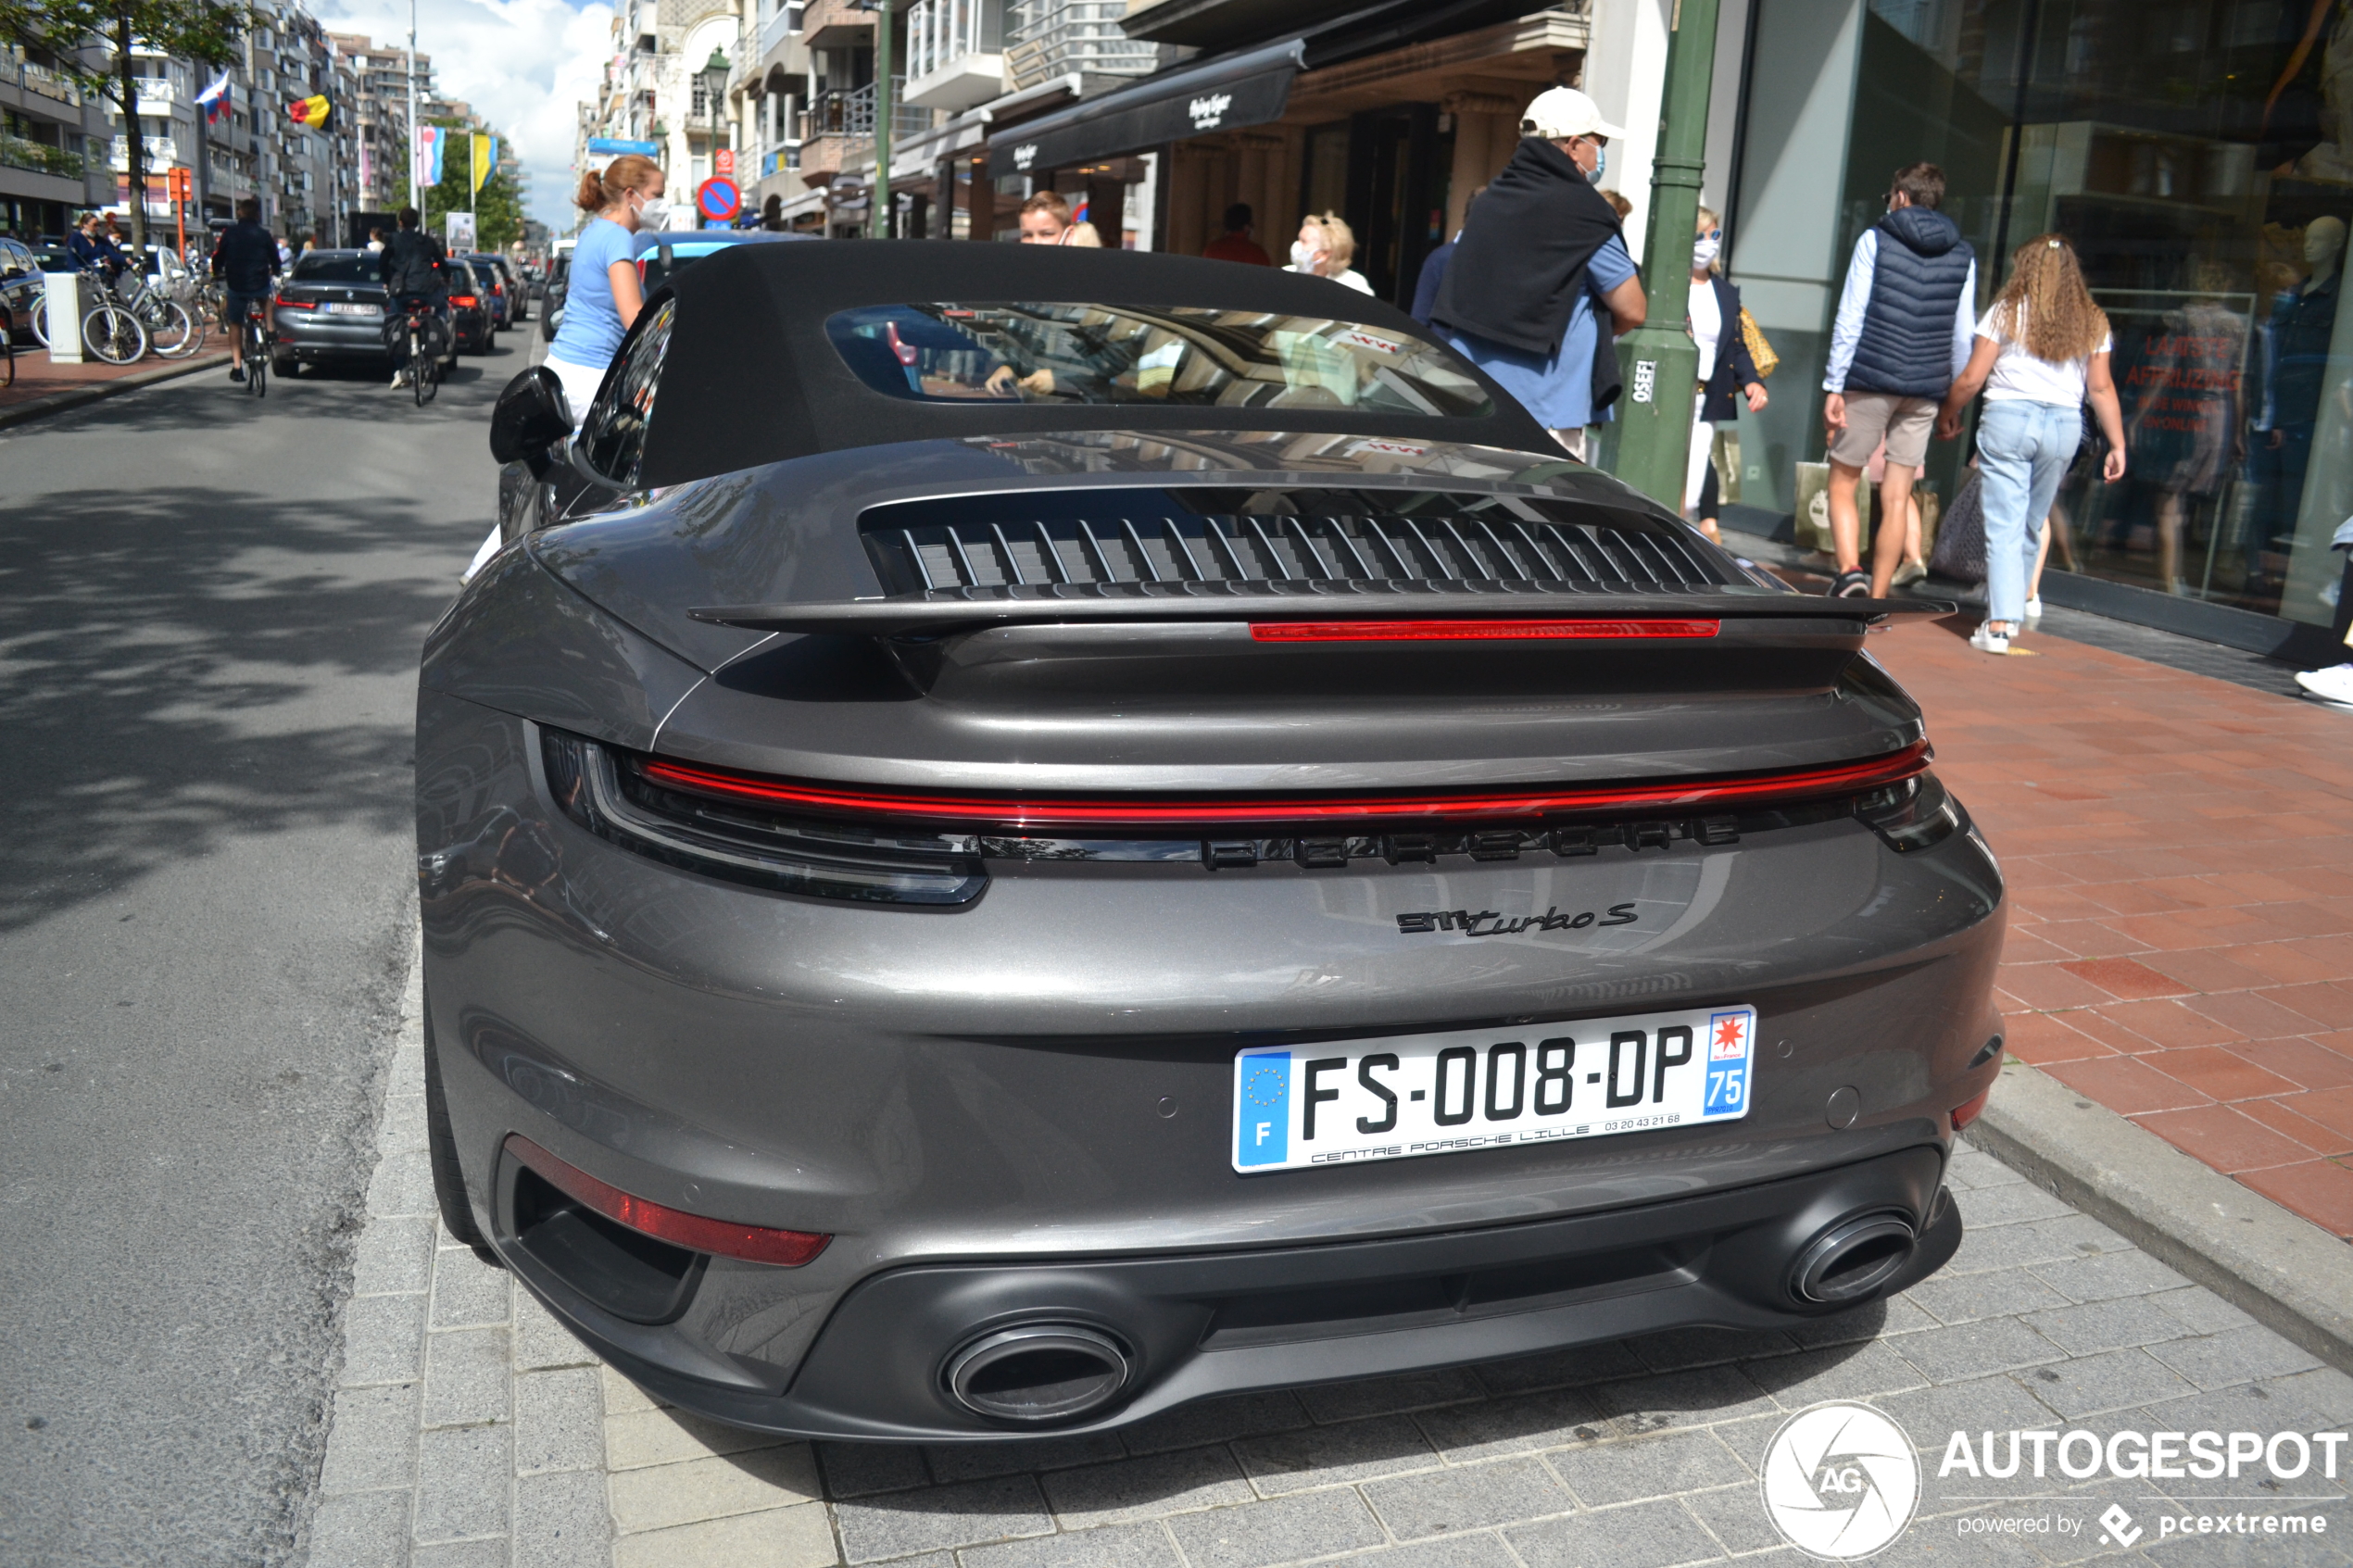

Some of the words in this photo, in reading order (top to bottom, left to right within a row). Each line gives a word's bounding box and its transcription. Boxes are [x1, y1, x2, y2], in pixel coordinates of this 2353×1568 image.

[2145, 335, 2231, 358] LAATSTE
[1204, 815, 1741, 871] PORSCHE
[1598, 903, 1639, 926] S
[1302, 1024, 1693, 1141] FS-008-DP
[1707, 1069, 1743, 1107] 75
[1256, 1122, 1271, 1146] F
[1311, 1146, 1402, 1163] CENTRE
[1410, 1134, 1512, 1153] PORSCHE
[1519, 1124, 1590, 1141] LILLE
[1604, 1123, 1617, 1131] 03
[1621, 1120, 1633, 1129] 20
[1636, 1118, 1649, 1127] 43
[1652, 1116, 1664, 1124] 21
[1667, 1114, 1680, 1123] 68
